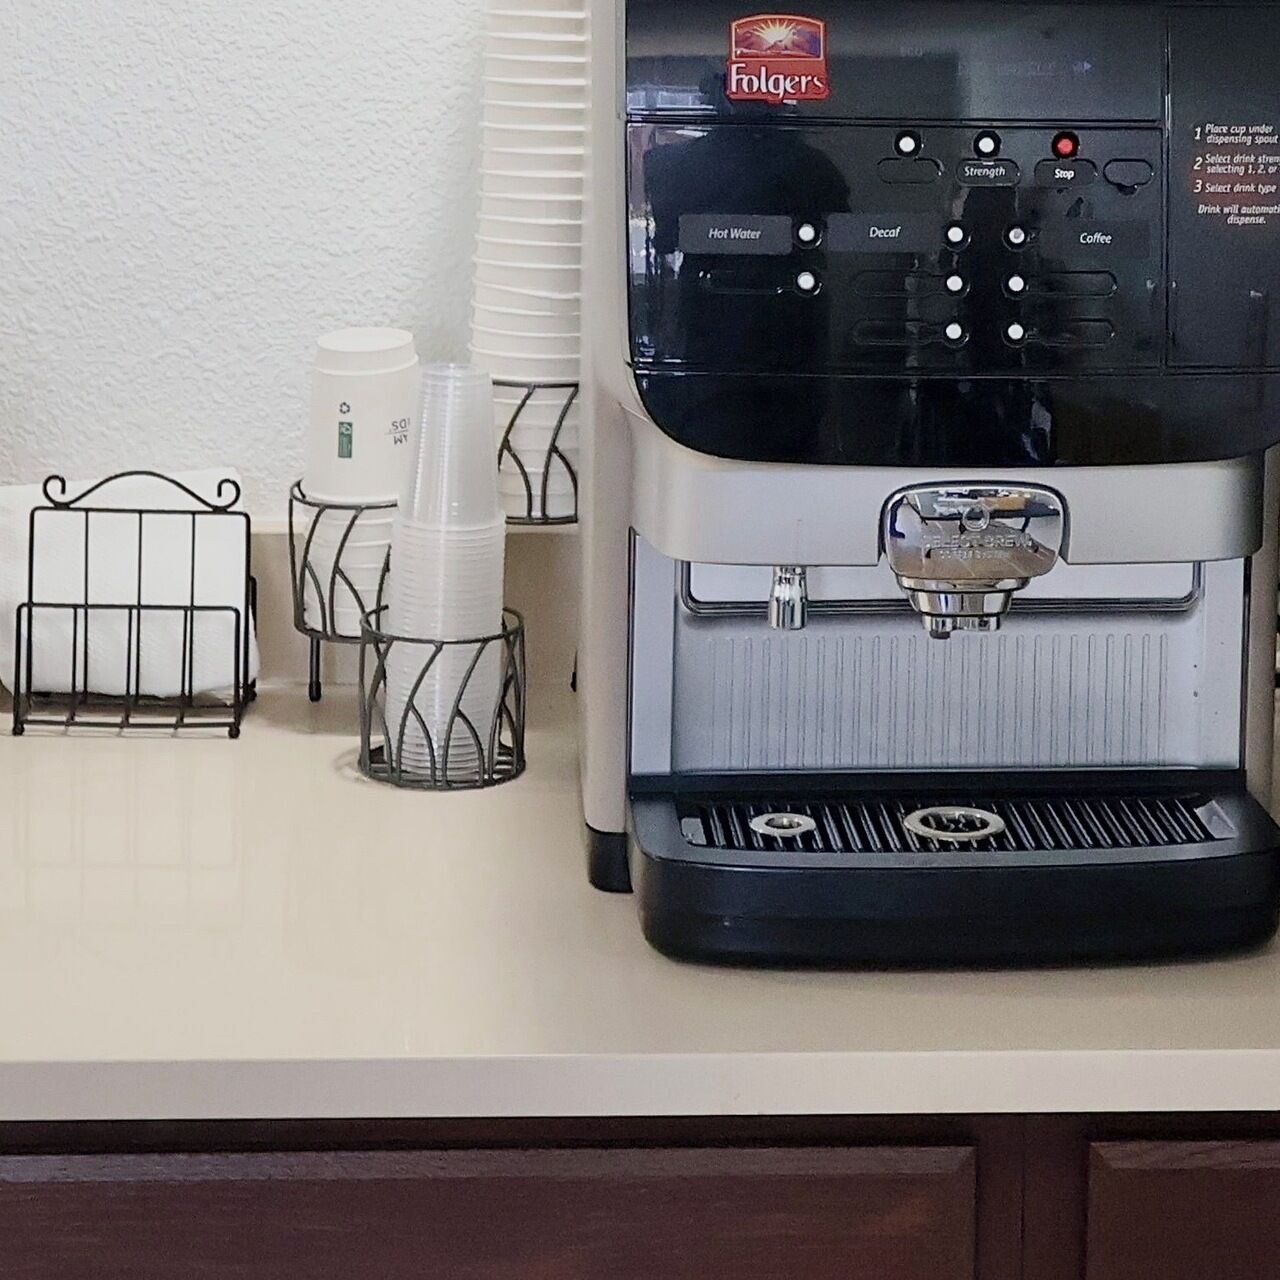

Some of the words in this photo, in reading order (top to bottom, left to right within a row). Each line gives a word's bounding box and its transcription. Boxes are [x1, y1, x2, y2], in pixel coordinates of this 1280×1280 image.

[730, 63, 825, 100] Folgers
[1194, 126, 1202, 140] 1
[1205, 123, 1228, 134] Place
[1230, 125, 1247, 136] cup
[1249, 123, 1273, 134] under
[1206, 134, 1252, 146] dispensing
[1254, 134, 1279, 144] spout
[1193, 156, 1203, 170] 2
[1205, 153, 1231, 164] Select
[1233, 153, 1256, 164] drink
[964, 165, 1007, 179] Strength
[1054, 168, 1075, 180] Stop
[1206, 164, 1245, 176] selecting
[1268, 166, 1278, 174] or
[1193, 179, 1203, 193] 3
[1205, 183, 1232, 193] Select
[1233, 183, 1256, 193] drink
[1257, 184, 1277, 195] type
[1198, 204, 1221, 214] Drink
[1223, 204, 1239, 214] will
[708, 227, 728, 239] Hot
[730, 227, 761, 240] Water
[869, 225, 902, 238] Decaf
[1079, 231, 1113, 245] Coffee
